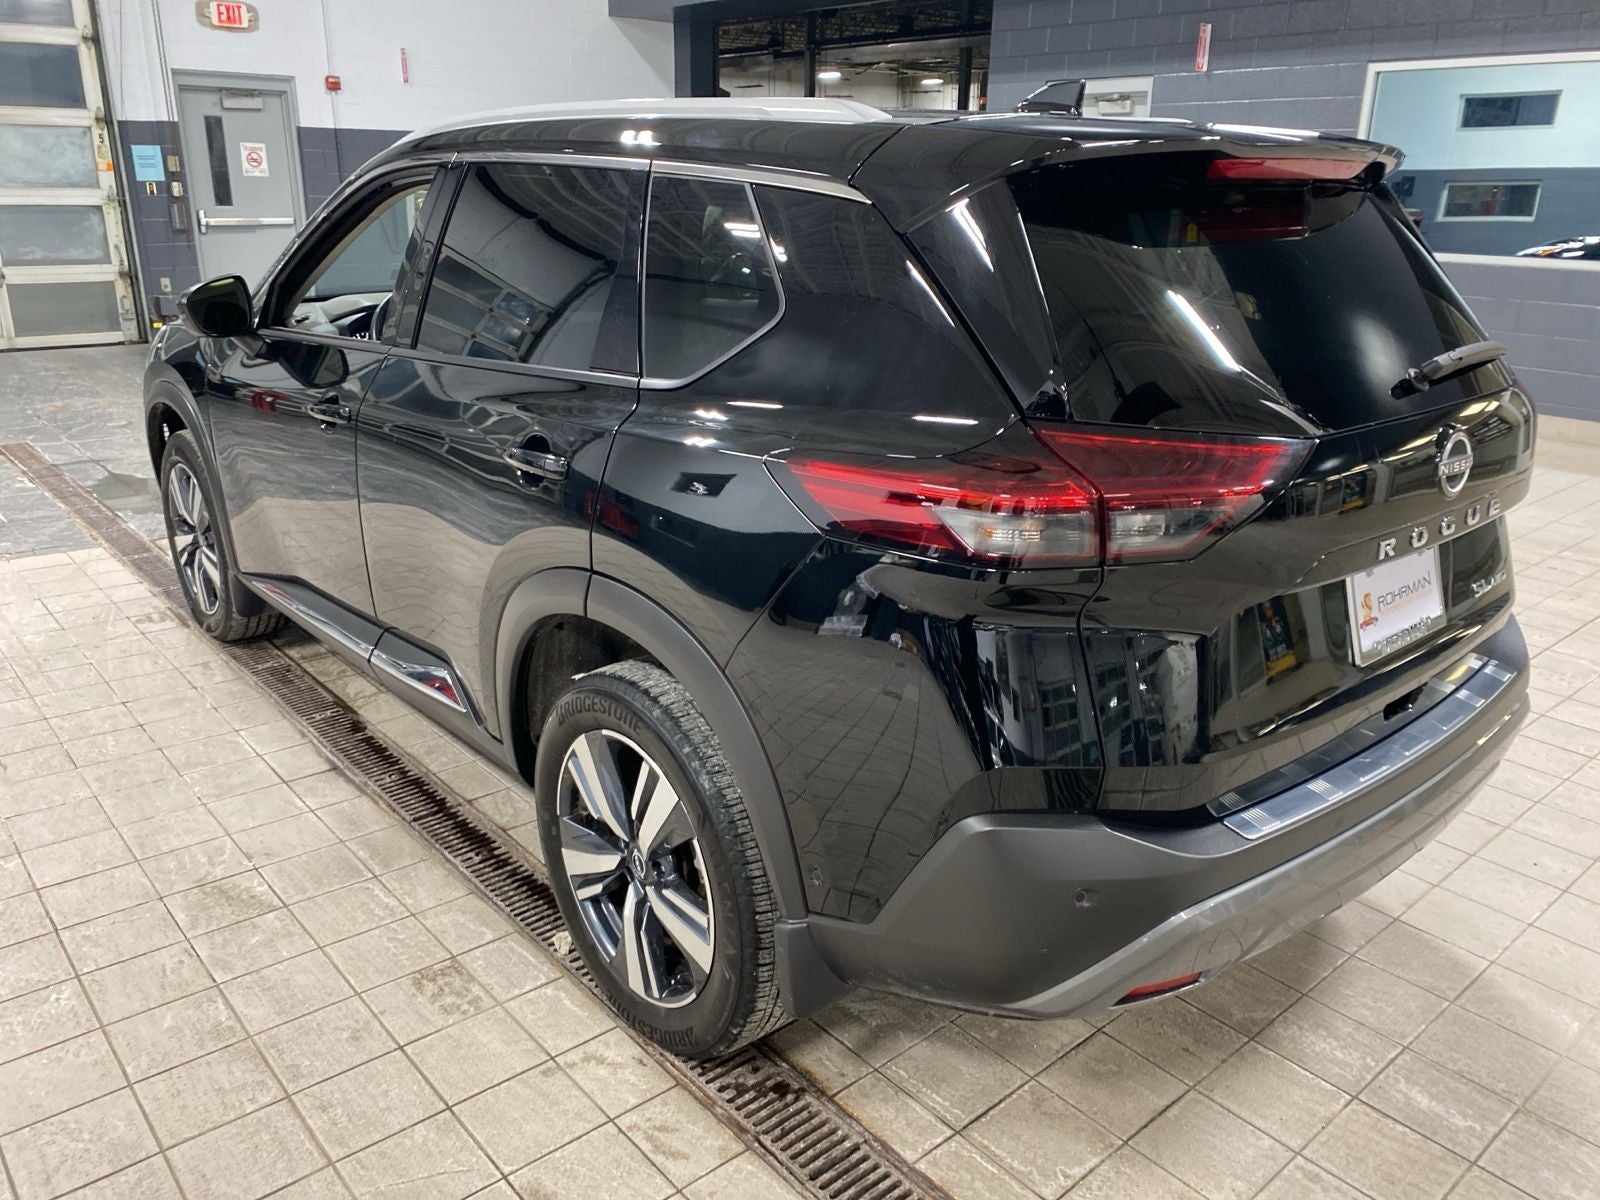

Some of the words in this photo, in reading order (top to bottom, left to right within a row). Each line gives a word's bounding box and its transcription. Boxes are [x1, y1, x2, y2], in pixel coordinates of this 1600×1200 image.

[216, 3, 243, 26] EXIT
[98, 133, 104, 144] 5
[1377, 497, 1501, 561] ROGUE
[1377, 570, 1432, 613] ROHRMAN
